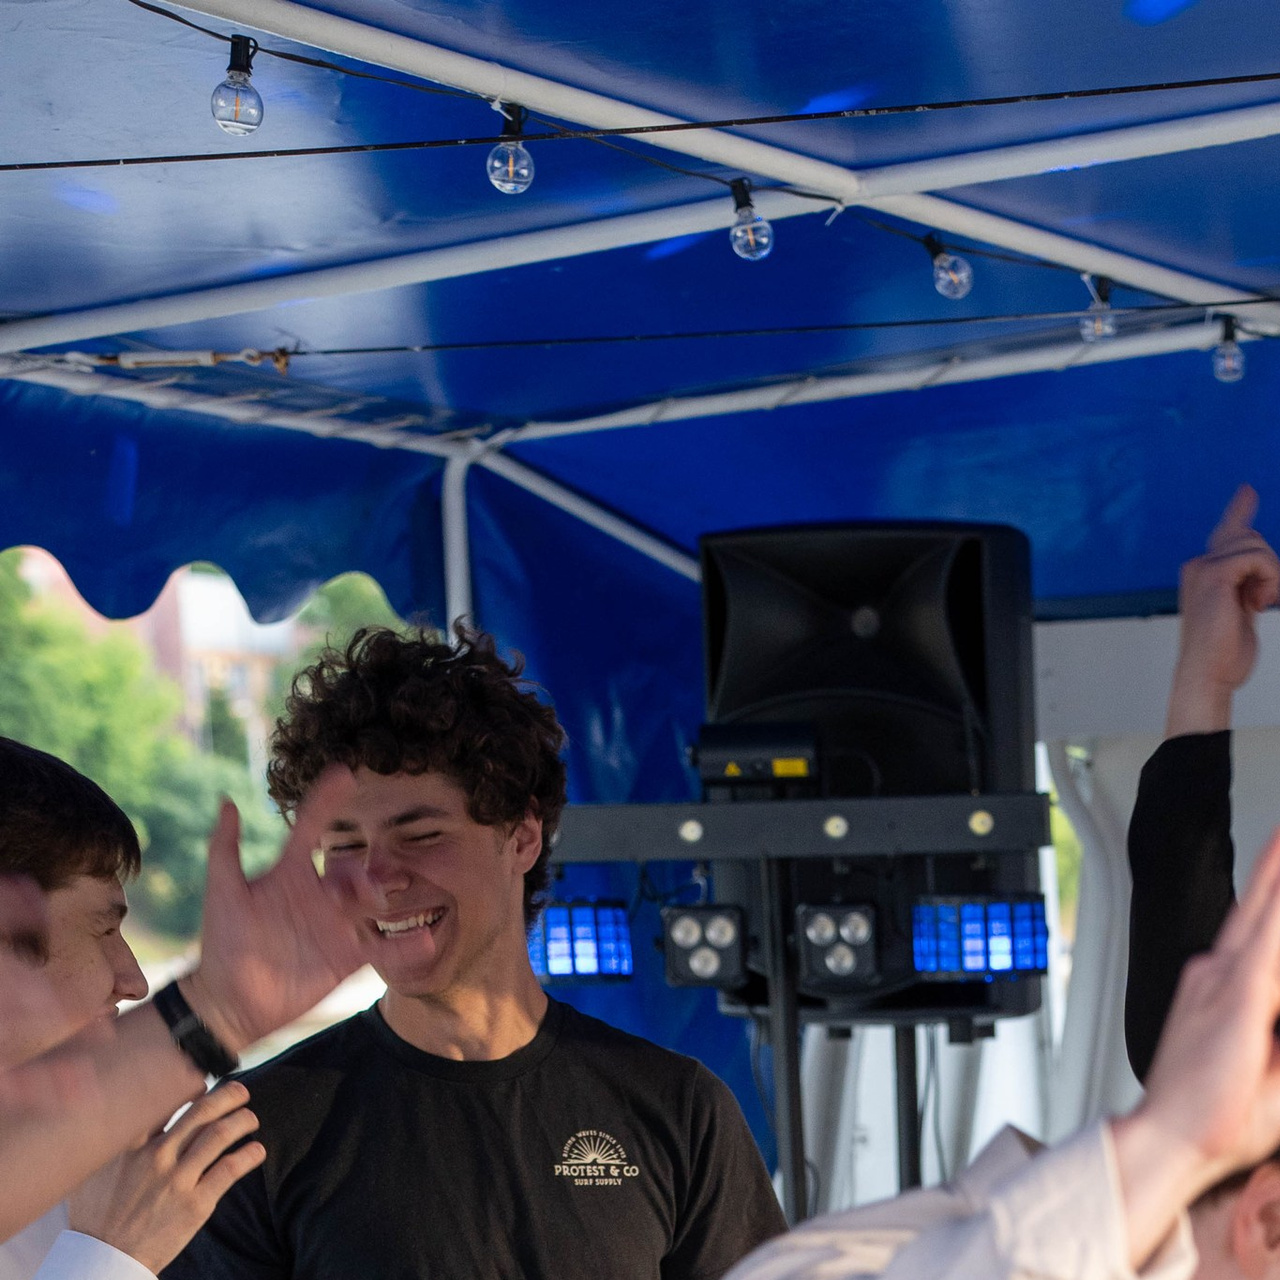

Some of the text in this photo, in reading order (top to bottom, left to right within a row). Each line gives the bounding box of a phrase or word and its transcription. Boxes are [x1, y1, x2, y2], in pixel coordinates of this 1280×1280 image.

[575, 1130, 598, 1138] WAVES
[598, 1131, 616, 1145] SINCE
[554, 1164, 640, 1177] PROTEST & CO
[574, 1178, 622, 1186] SURF SUPPLY
